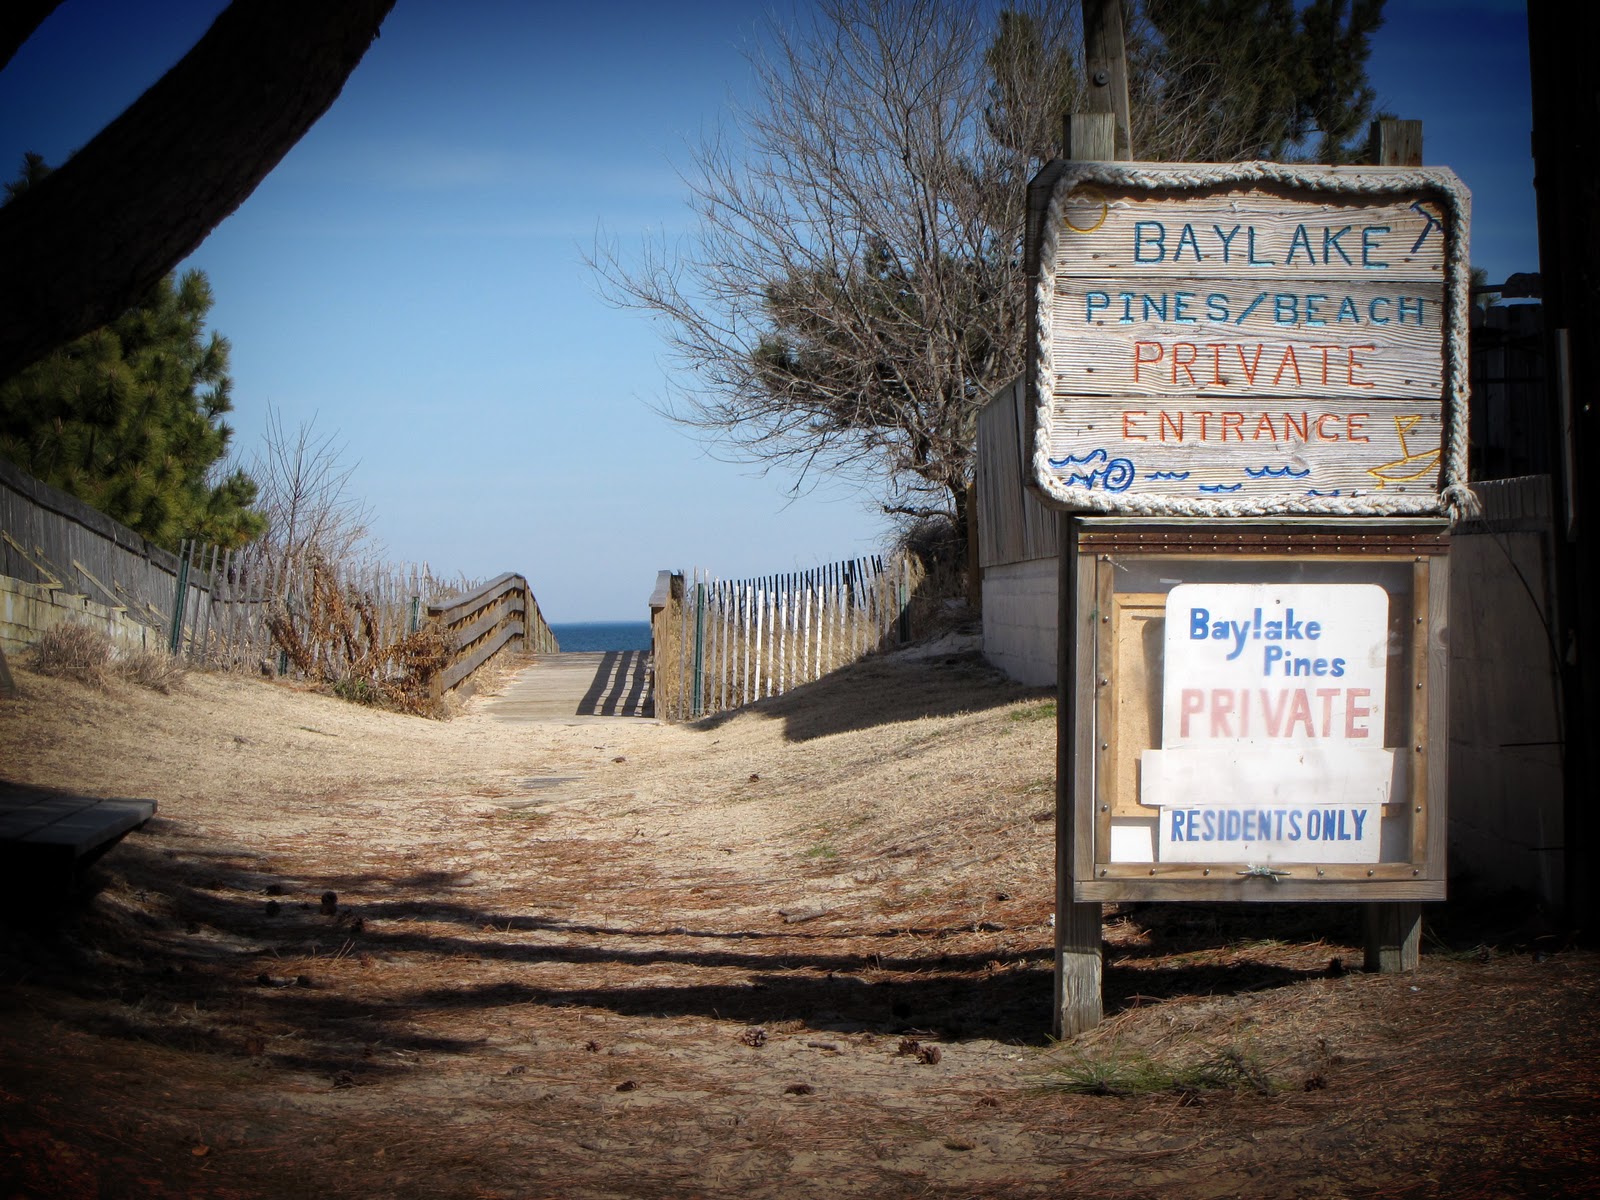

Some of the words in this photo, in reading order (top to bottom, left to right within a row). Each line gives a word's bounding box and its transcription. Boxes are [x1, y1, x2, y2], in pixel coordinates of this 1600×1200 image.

[1133, 221, 1390, 269] BAYLAKE
[1085, 291, 1425, 327] PINES/BEACH
[1133, 341, 1376, 388] PRIVATE
[1121, 411, 1370, 443] ENTRANCE
[1189, 607, 1321, 661] Baylake
[1263, 645, 1346, 677] Pines
[1180, 688, 1371, 738] PRIVATE
[1170, 809, 1301, 842] RESIDENTS
[1306, 809, 1367, 841] ONLY
